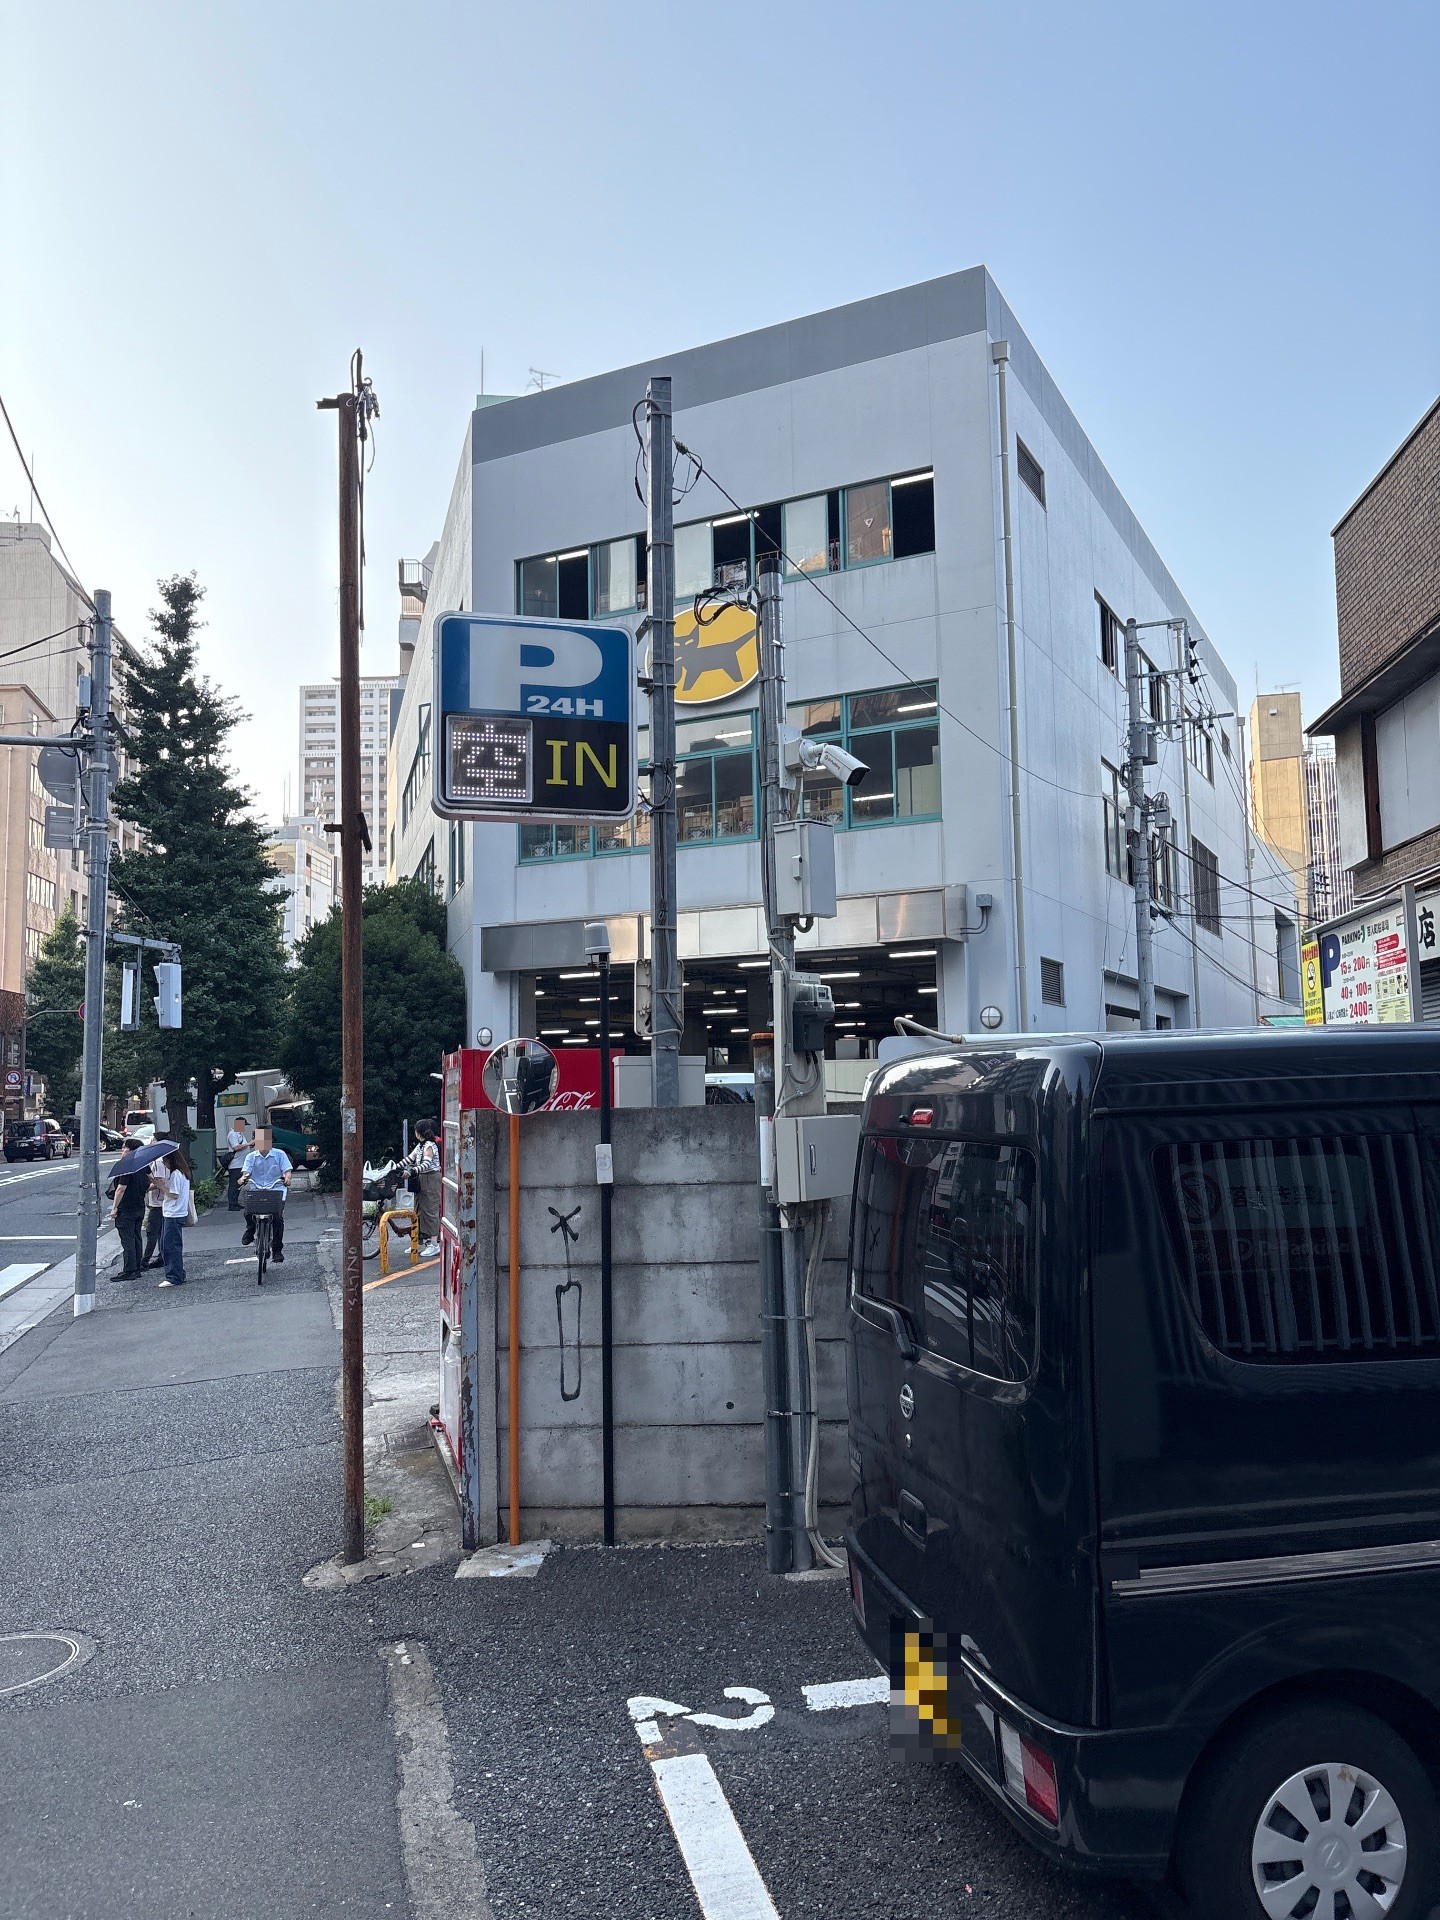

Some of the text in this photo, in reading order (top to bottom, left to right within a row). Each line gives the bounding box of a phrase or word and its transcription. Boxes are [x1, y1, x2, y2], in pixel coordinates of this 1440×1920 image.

[469, 623, 603, 711] P
[527, 695, 603, 717] 24H
[453, 724, 527, 797] 空
[545, 739, 617, 789] IN
[1418, 905, 1436, 949] 店
[1321, 933, 1341, 989] P
